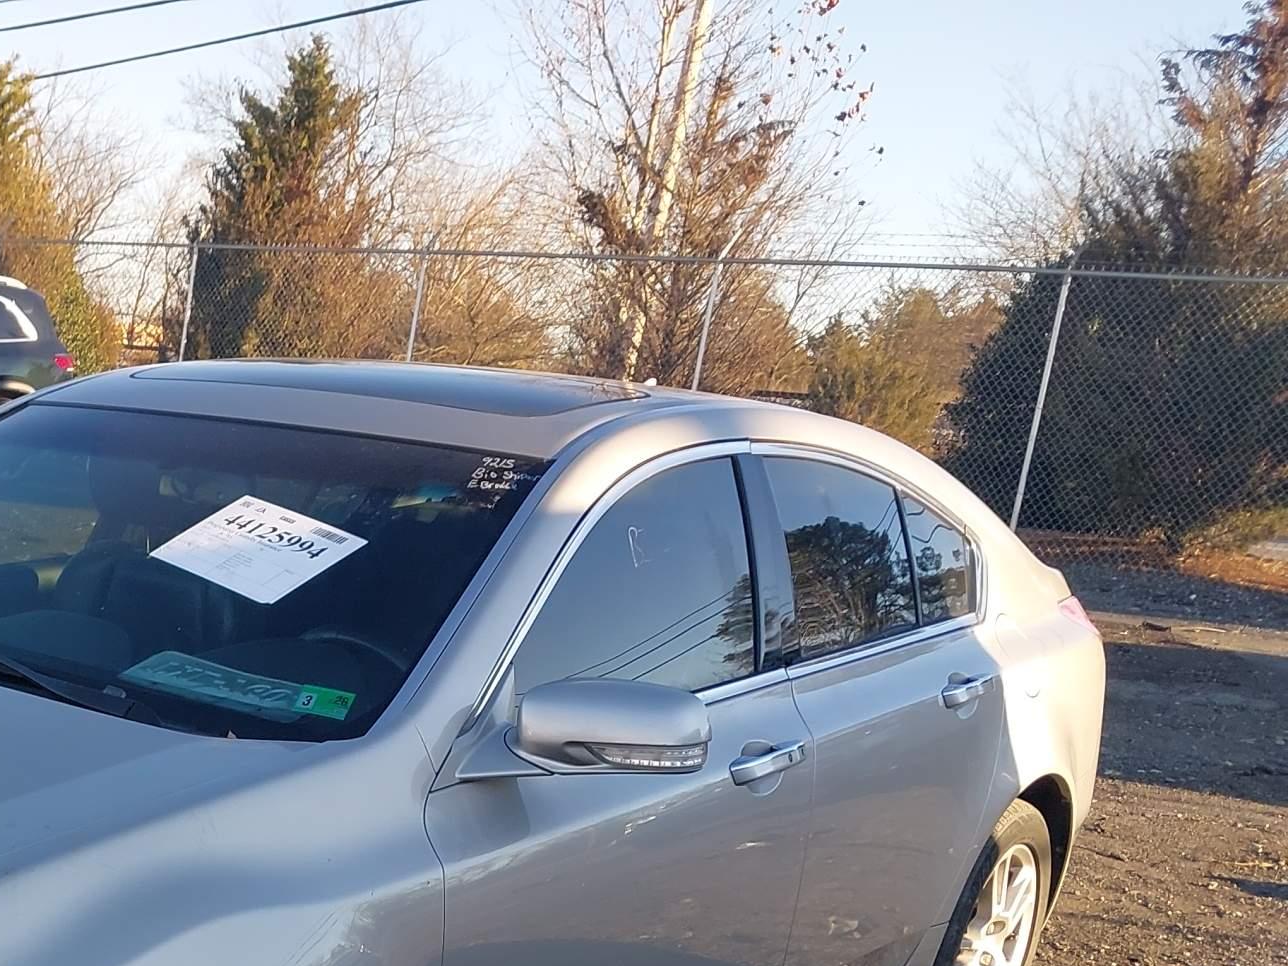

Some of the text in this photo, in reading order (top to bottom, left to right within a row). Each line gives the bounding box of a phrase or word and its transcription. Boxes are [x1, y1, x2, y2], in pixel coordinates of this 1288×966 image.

[482, 457, 515, 468] 9215
[224, 514, 329, 560] 44125994
[302, 695, 313, 706] 3
